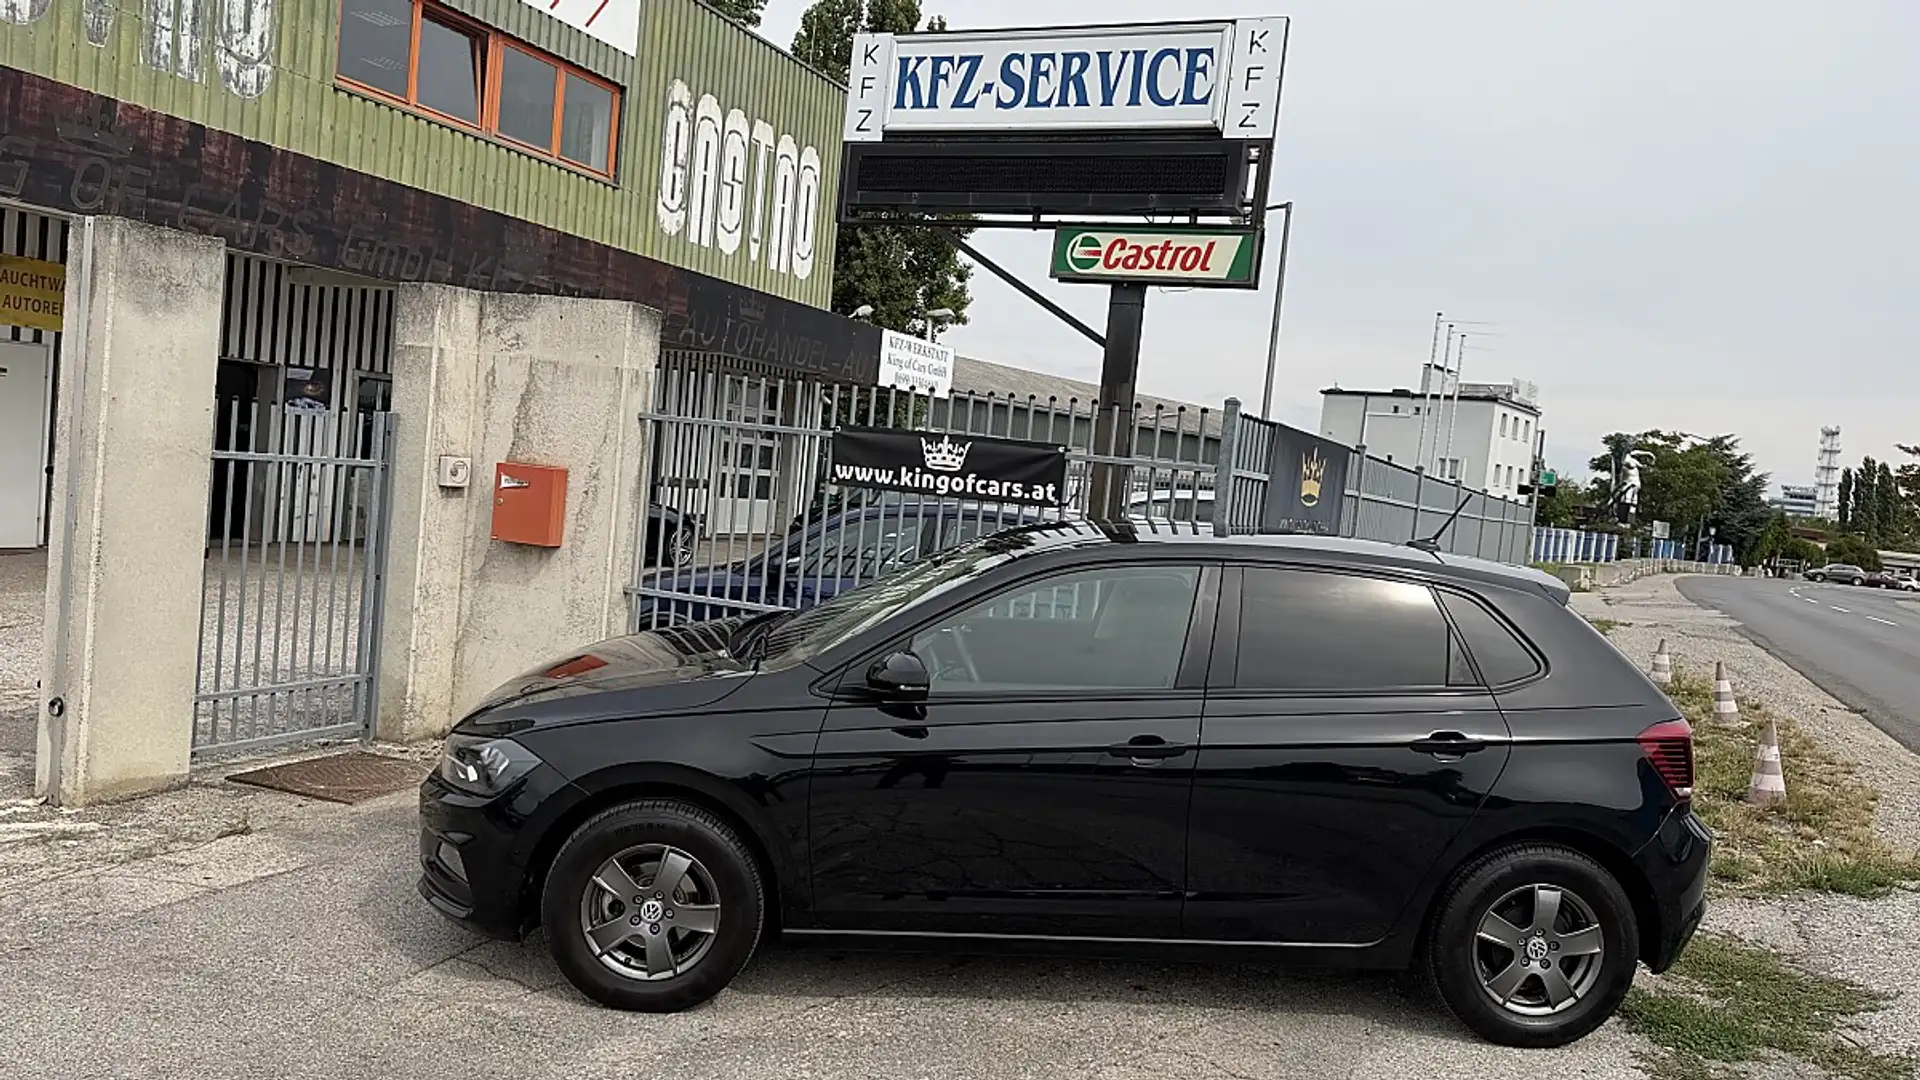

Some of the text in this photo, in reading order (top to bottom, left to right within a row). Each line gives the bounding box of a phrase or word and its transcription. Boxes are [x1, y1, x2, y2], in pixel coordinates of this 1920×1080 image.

[856, 43, 879, 132] KFZ
[893, 47, 1214, 109] KFZ-SERVICE
[1238, 30, 1269, 128] KFZ
[1102, 238, 1216, 272] Castrol
[835, 464, 1058, 501] www.kingofcars.at
